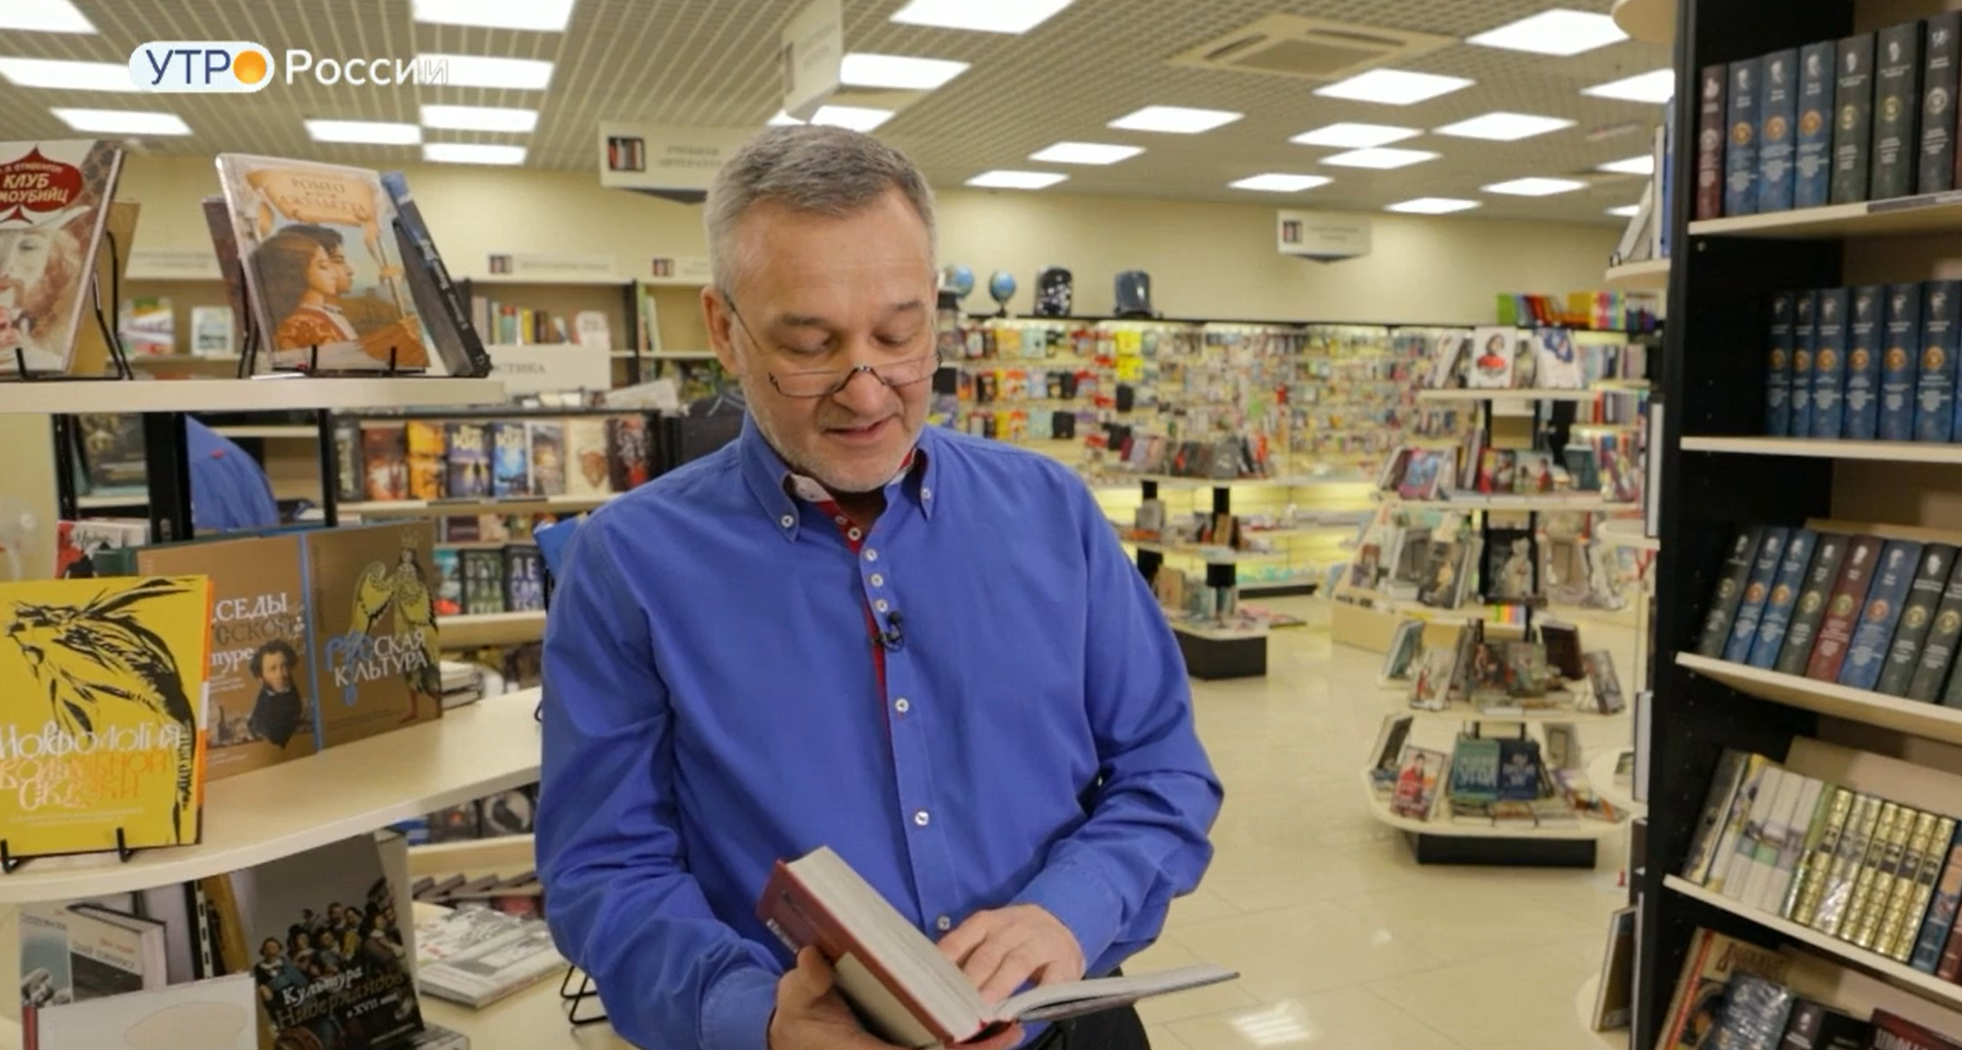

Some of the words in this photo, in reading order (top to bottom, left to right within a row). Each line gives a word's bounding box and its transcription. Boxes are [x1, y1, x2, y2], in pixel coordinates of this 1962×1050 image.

[3, 172, 51, 190] КЛУБ
[491, 362, 546, 375] СТИКА
[211, 590, 288, 623] СЕДЫ
[281, 965, 364, 1008] Культура
